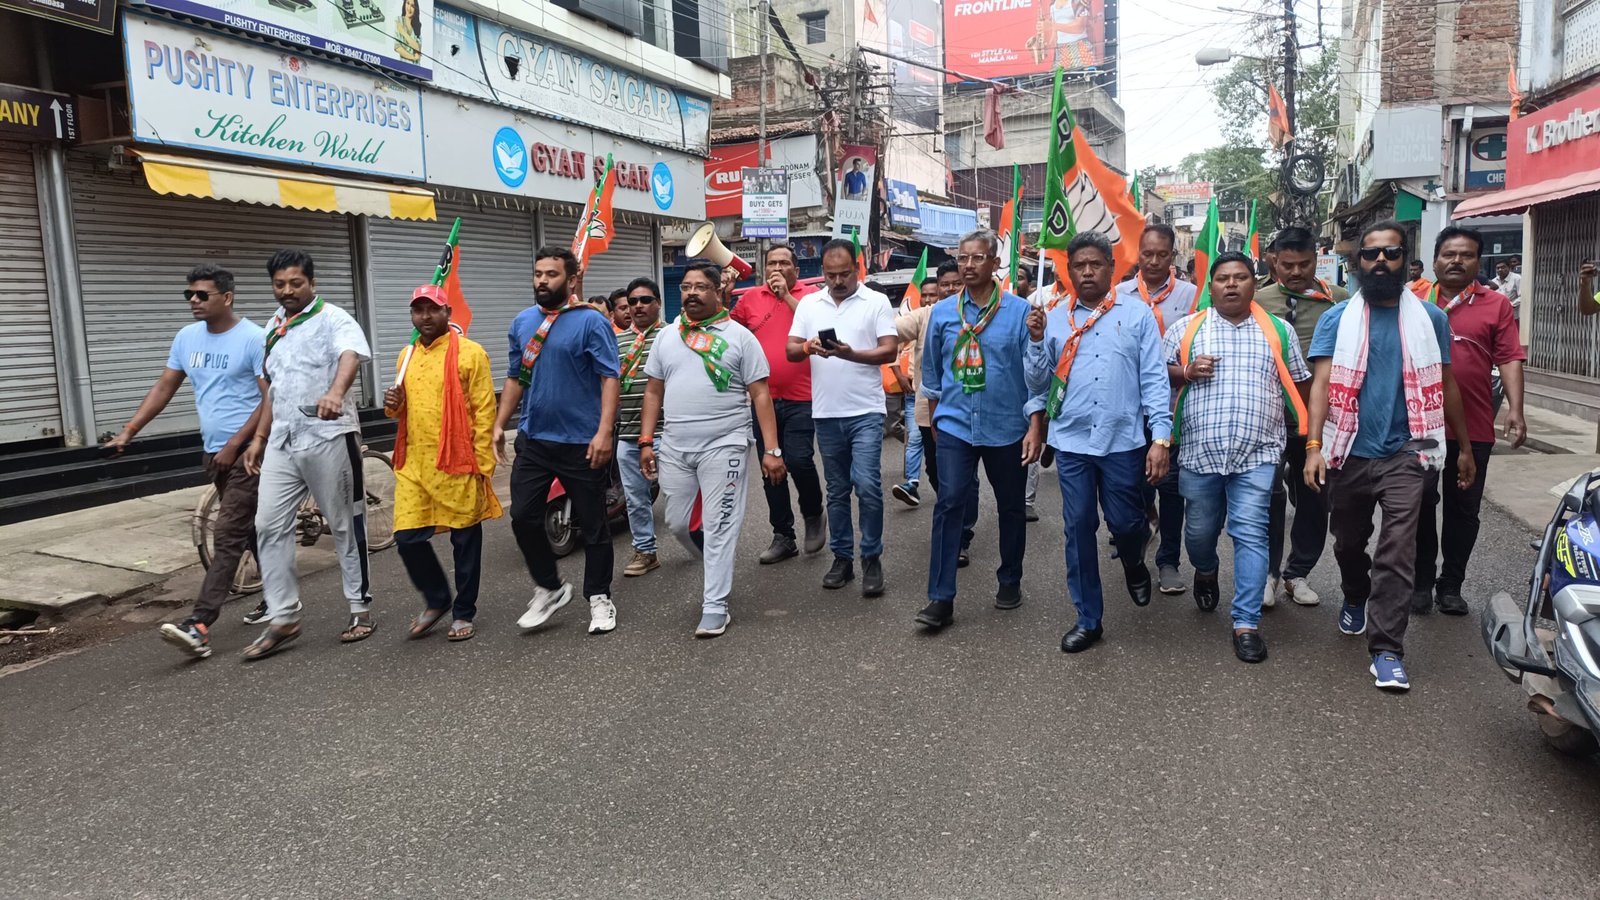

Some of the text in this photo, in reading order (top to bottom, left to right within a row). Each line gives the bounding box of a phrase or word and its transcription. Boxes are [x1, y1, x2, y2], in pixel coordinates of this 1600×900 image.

[224, 14, 311, 45] PUSHTY ENTERPRISES
[325, 42, 344, 54] MOB:
[143, 40, 412, 132] PUSHTY ENTERPRISES
[497, 32, 582, 97] GYAN
[590, 63, 673, 125] SAGAR
[65, 104, 74, 126] FLOOR
[195, 110, 385, 164] Kitchen World
[531, 142, 651, 192] GYAN SGAR
[716, 170, 742, 184] RU
[1486, 173, 1506, 184] CHE
[839, 210, 865, 220] PUJA
[189, 351, 229, 369] UNPLUG
